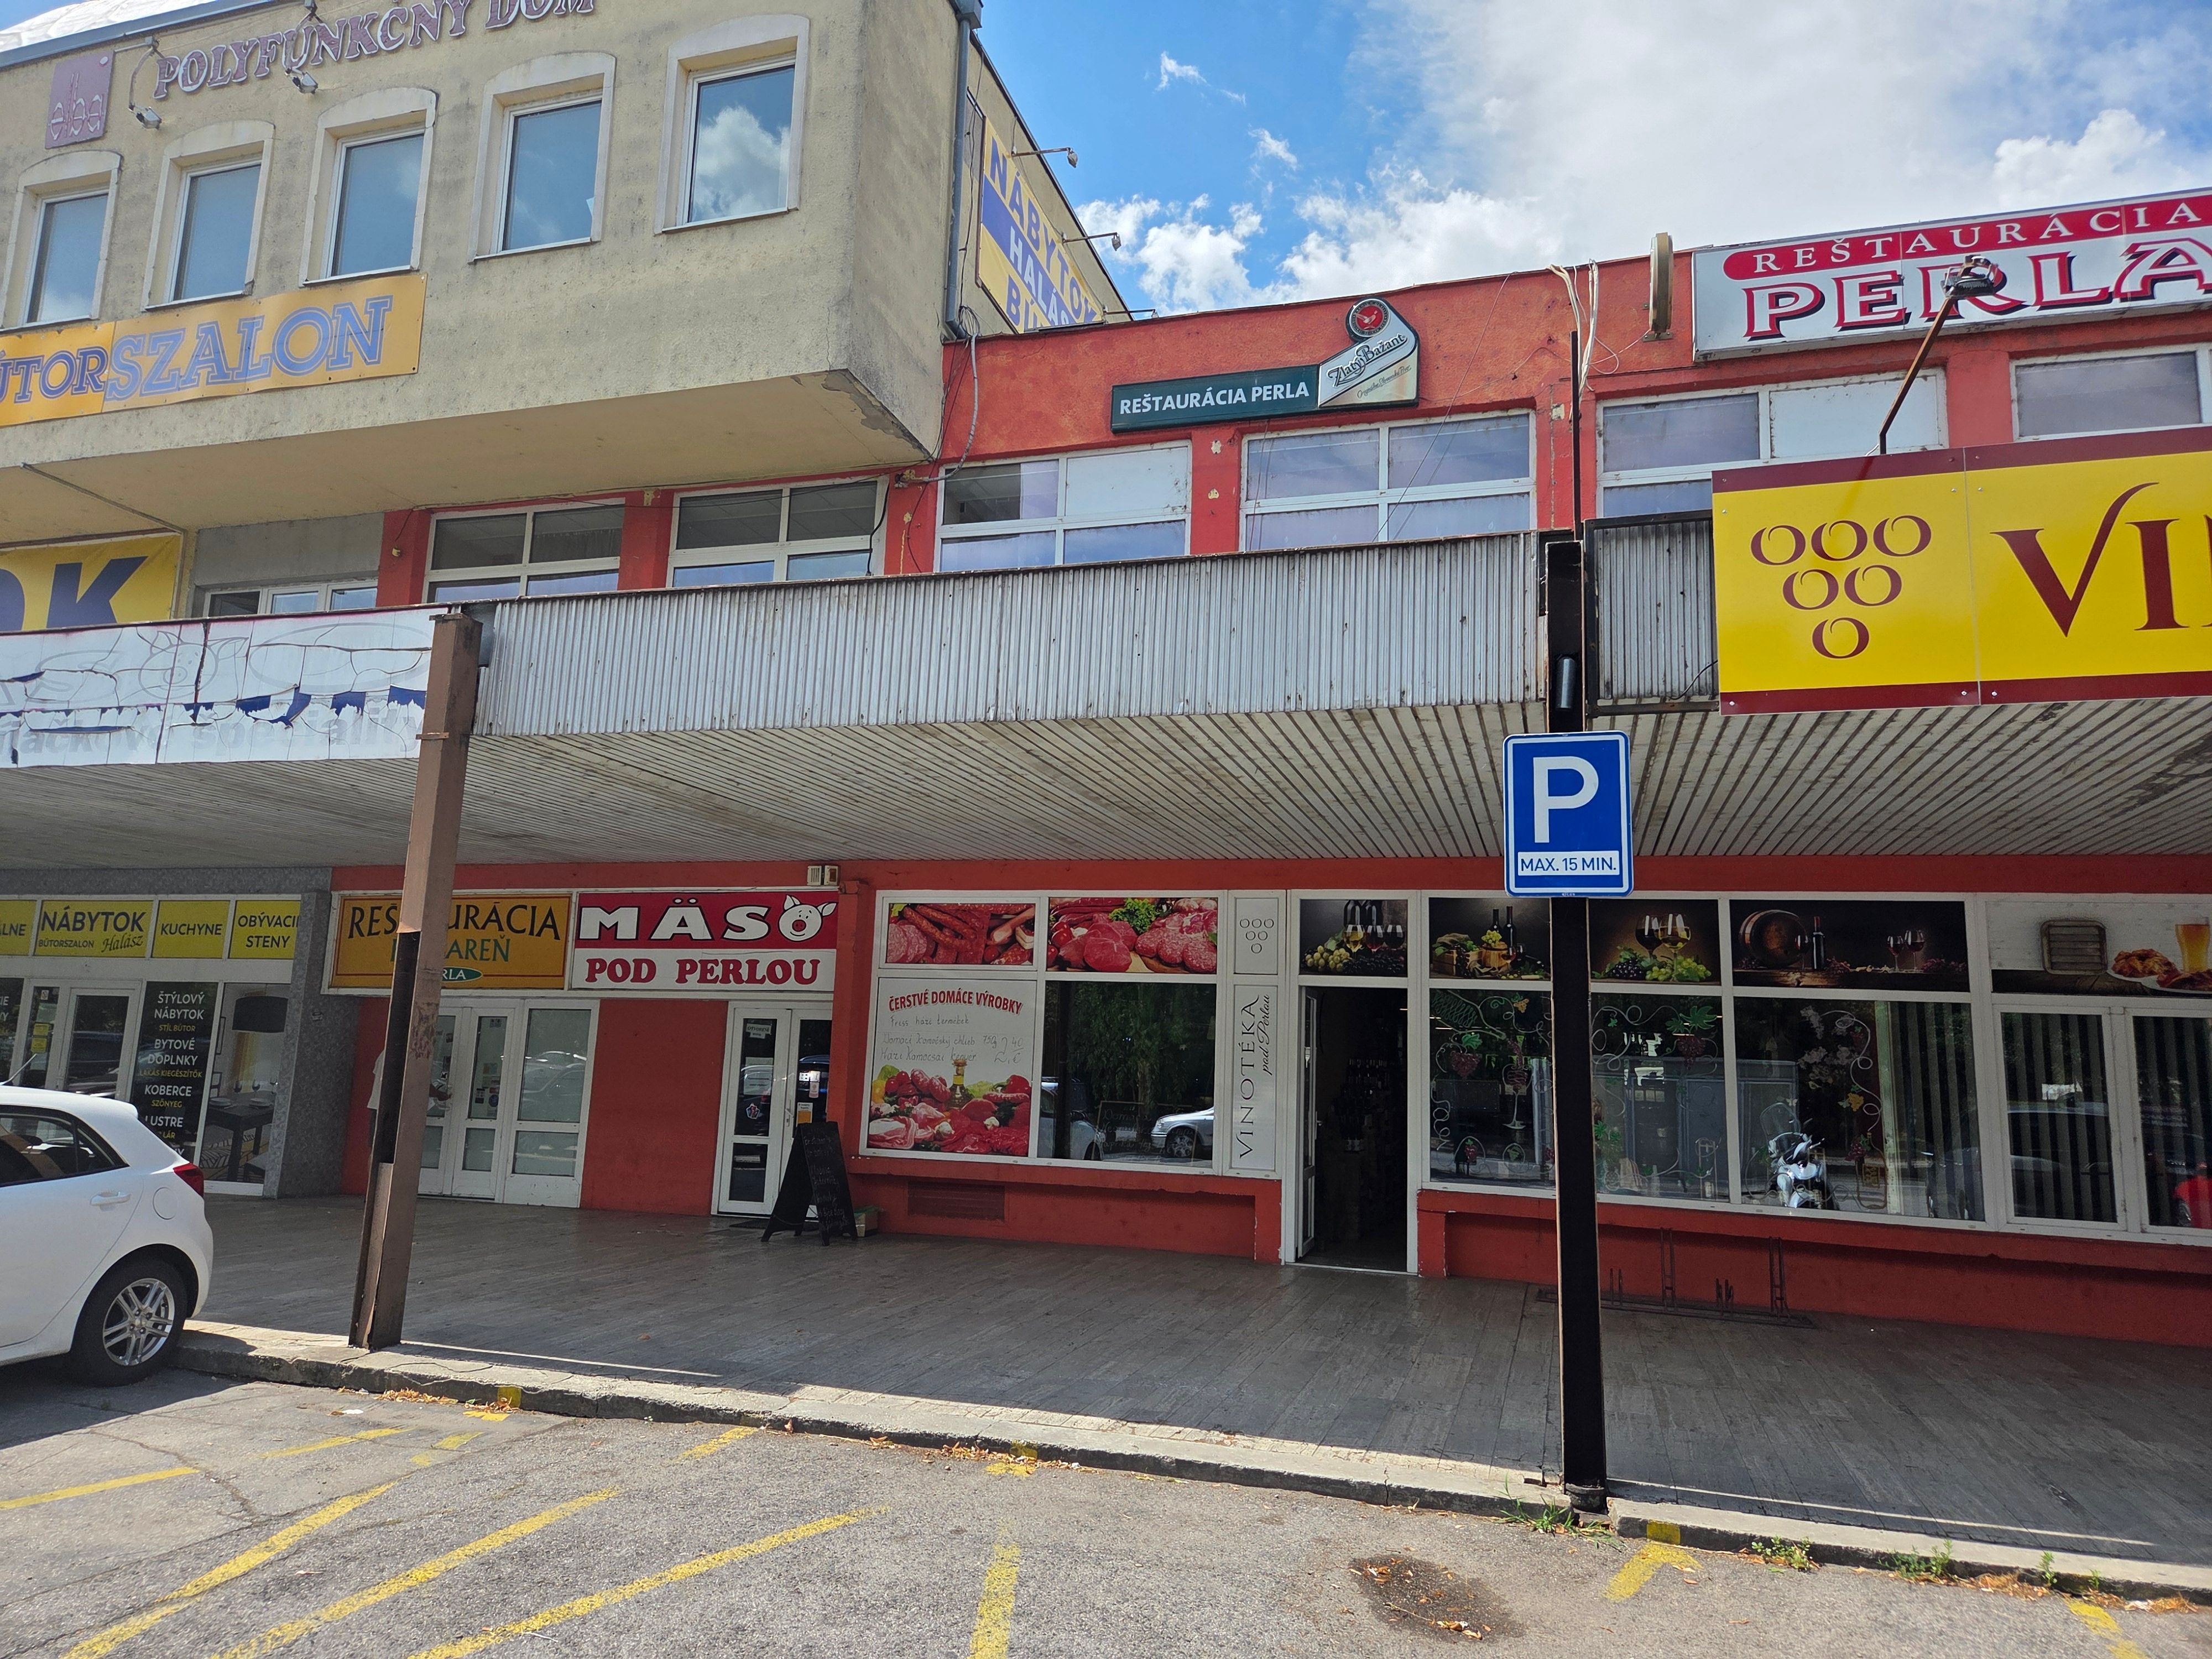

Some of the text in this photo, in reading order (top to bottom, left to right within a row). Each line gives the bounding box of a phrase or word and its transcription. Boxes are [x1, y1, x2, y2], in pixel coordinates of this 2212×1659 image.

[989, 135, 1097, 325] NÁBYTOK
[1754, 202, 2201, 273] REŠTAURÁCIA
[1742, 237, 2212, 341] PERLA
[1120, 382, 1310, 414] REŠTAURÁCIA PERLA
[1990, 482, 2212, 637] VI
[0, 556, 149, 632] K
[1533, 757, 1600, 843] P
[1521, 857, 1616, 871] MAX. 15 MIN.
[0, 923, 27, 936] LNE
[41, 905, 147, 932] NÁBYTOK
[161, 924, 223, 935] KUCHYNE
[238, 912, 299, 927] OBÝVACI
[348, 902, 560, 940] REŠURÁCIA
[38, 933, 144, 953] BÚTORSZALON Halász
[246, 935, 290, 948] STENY
[585, 958, 821, 985] POD PERLOU
[157, 991, 205, 1004] ŠTÝLOVÝ
[889, 988, 1023, 1015] ČERSTVÉ DOMÁCE VÝROBKY
[154, 1006, 205, 1020] NÁBYTOK
[154, 1037, 195, 1050] BYTOVÉ
[1256, 994, 1272, 1076] pod Perlou
[147, 1054, 198, 1066] DOPLNKY
[1235, 994, 1260, 1159] VINOTÉKA
[144, 1084, 192, 1097] KOBERCE
